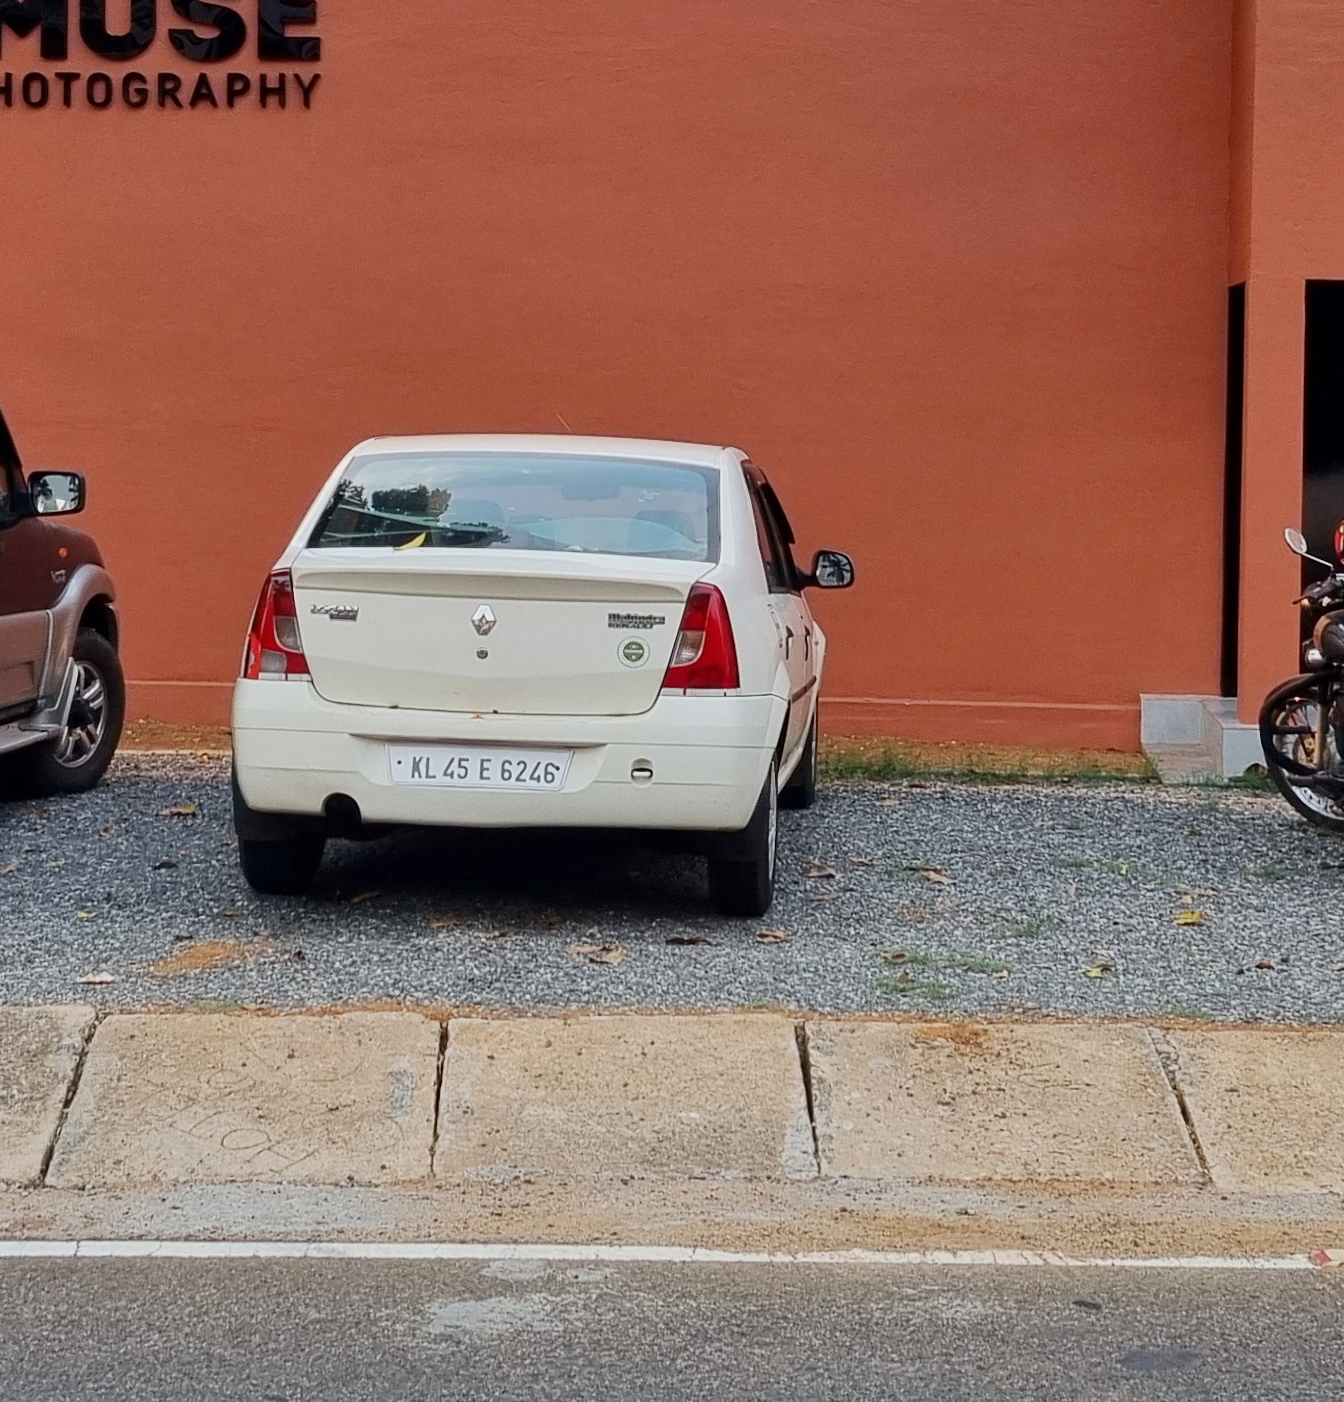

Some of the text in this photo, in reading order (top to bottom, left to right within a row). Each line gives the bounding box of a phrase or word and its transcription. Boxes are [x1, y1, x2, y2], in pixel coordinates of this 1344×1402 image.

[411, 756, 557, 785] KL 45 E 6246
